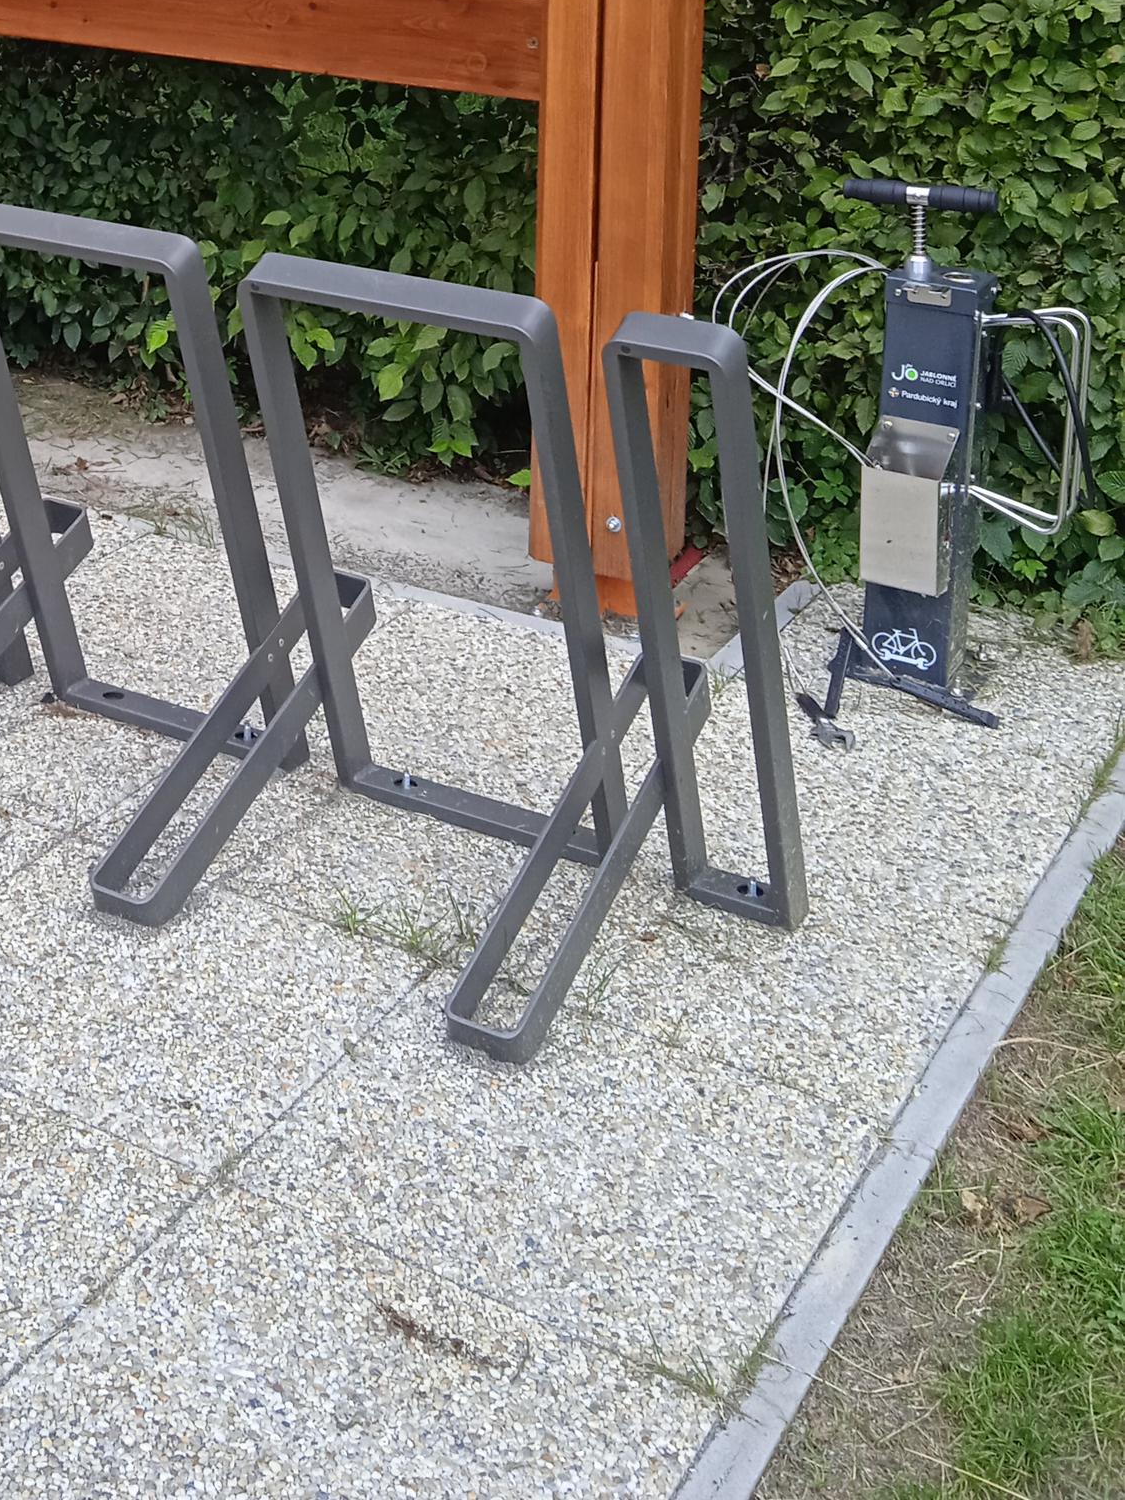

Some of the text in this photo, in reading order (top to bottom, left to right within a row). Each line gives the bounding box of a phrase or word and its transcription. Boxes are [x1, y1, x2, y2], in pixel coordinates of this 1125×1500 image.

[920, 376, 934, 384] NAD
[901, 390, 958, 409] Pardubický kraj
